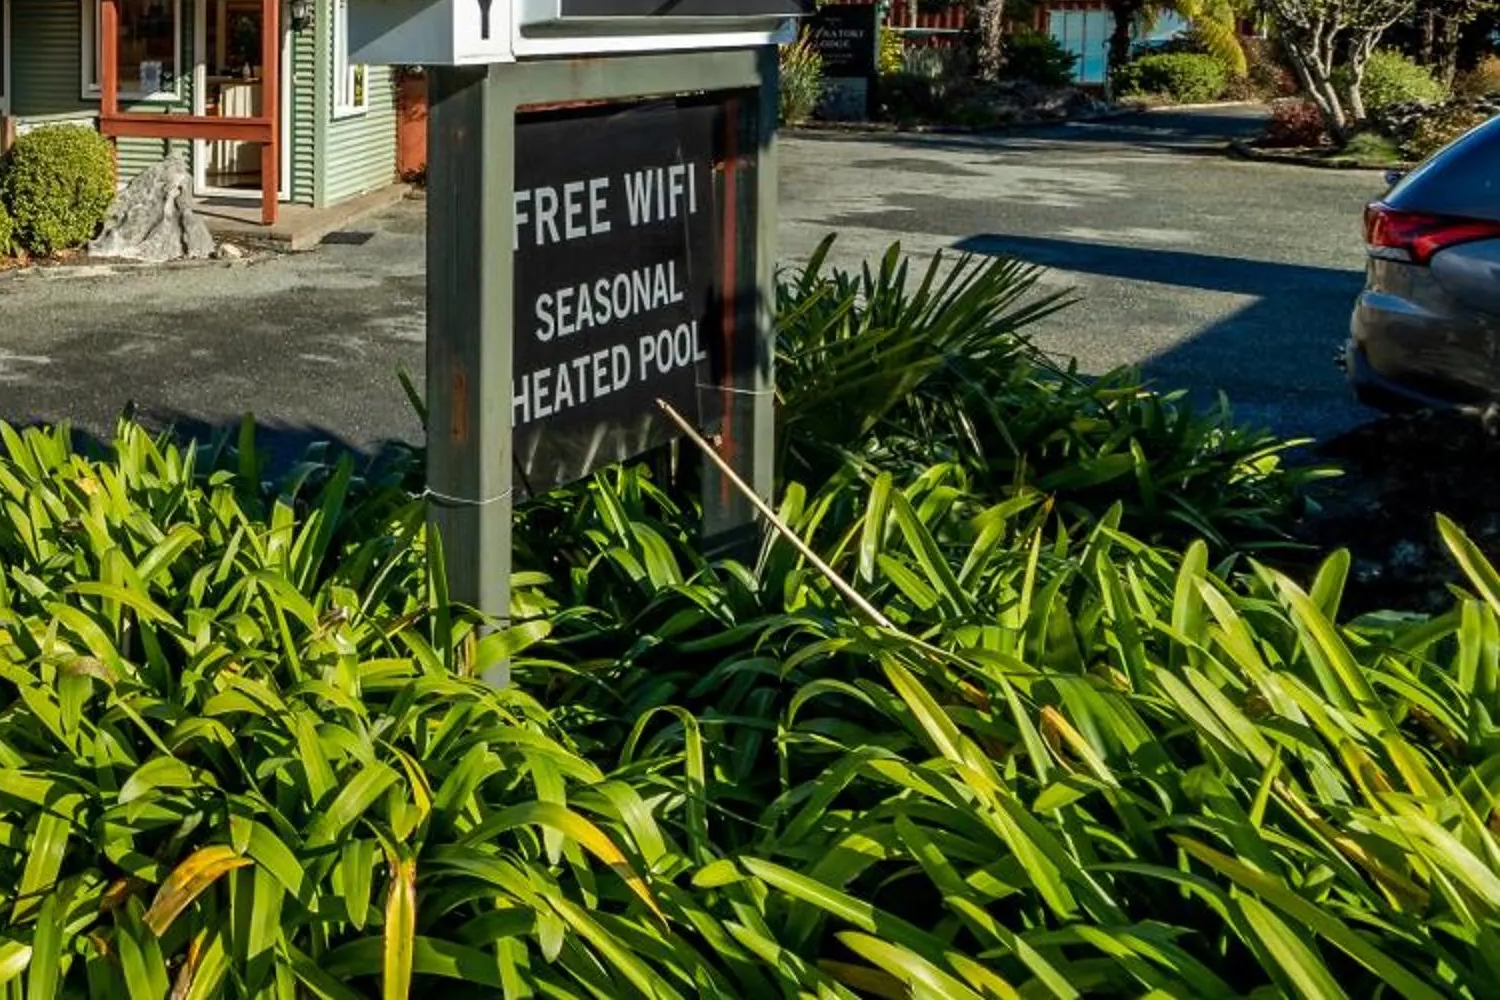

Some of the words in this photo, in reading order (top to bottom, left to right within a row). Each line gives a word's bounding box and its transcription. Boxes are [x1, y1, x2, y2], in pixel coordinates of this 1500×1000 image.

[513, 176, 611, 251] FREE
[624, 162, 697, 226] WIFI
[535, 260, 683, 342] SEASONAL
[512, 344, 631, 428] HEATED
[639, 321, 706, 380] POOL
